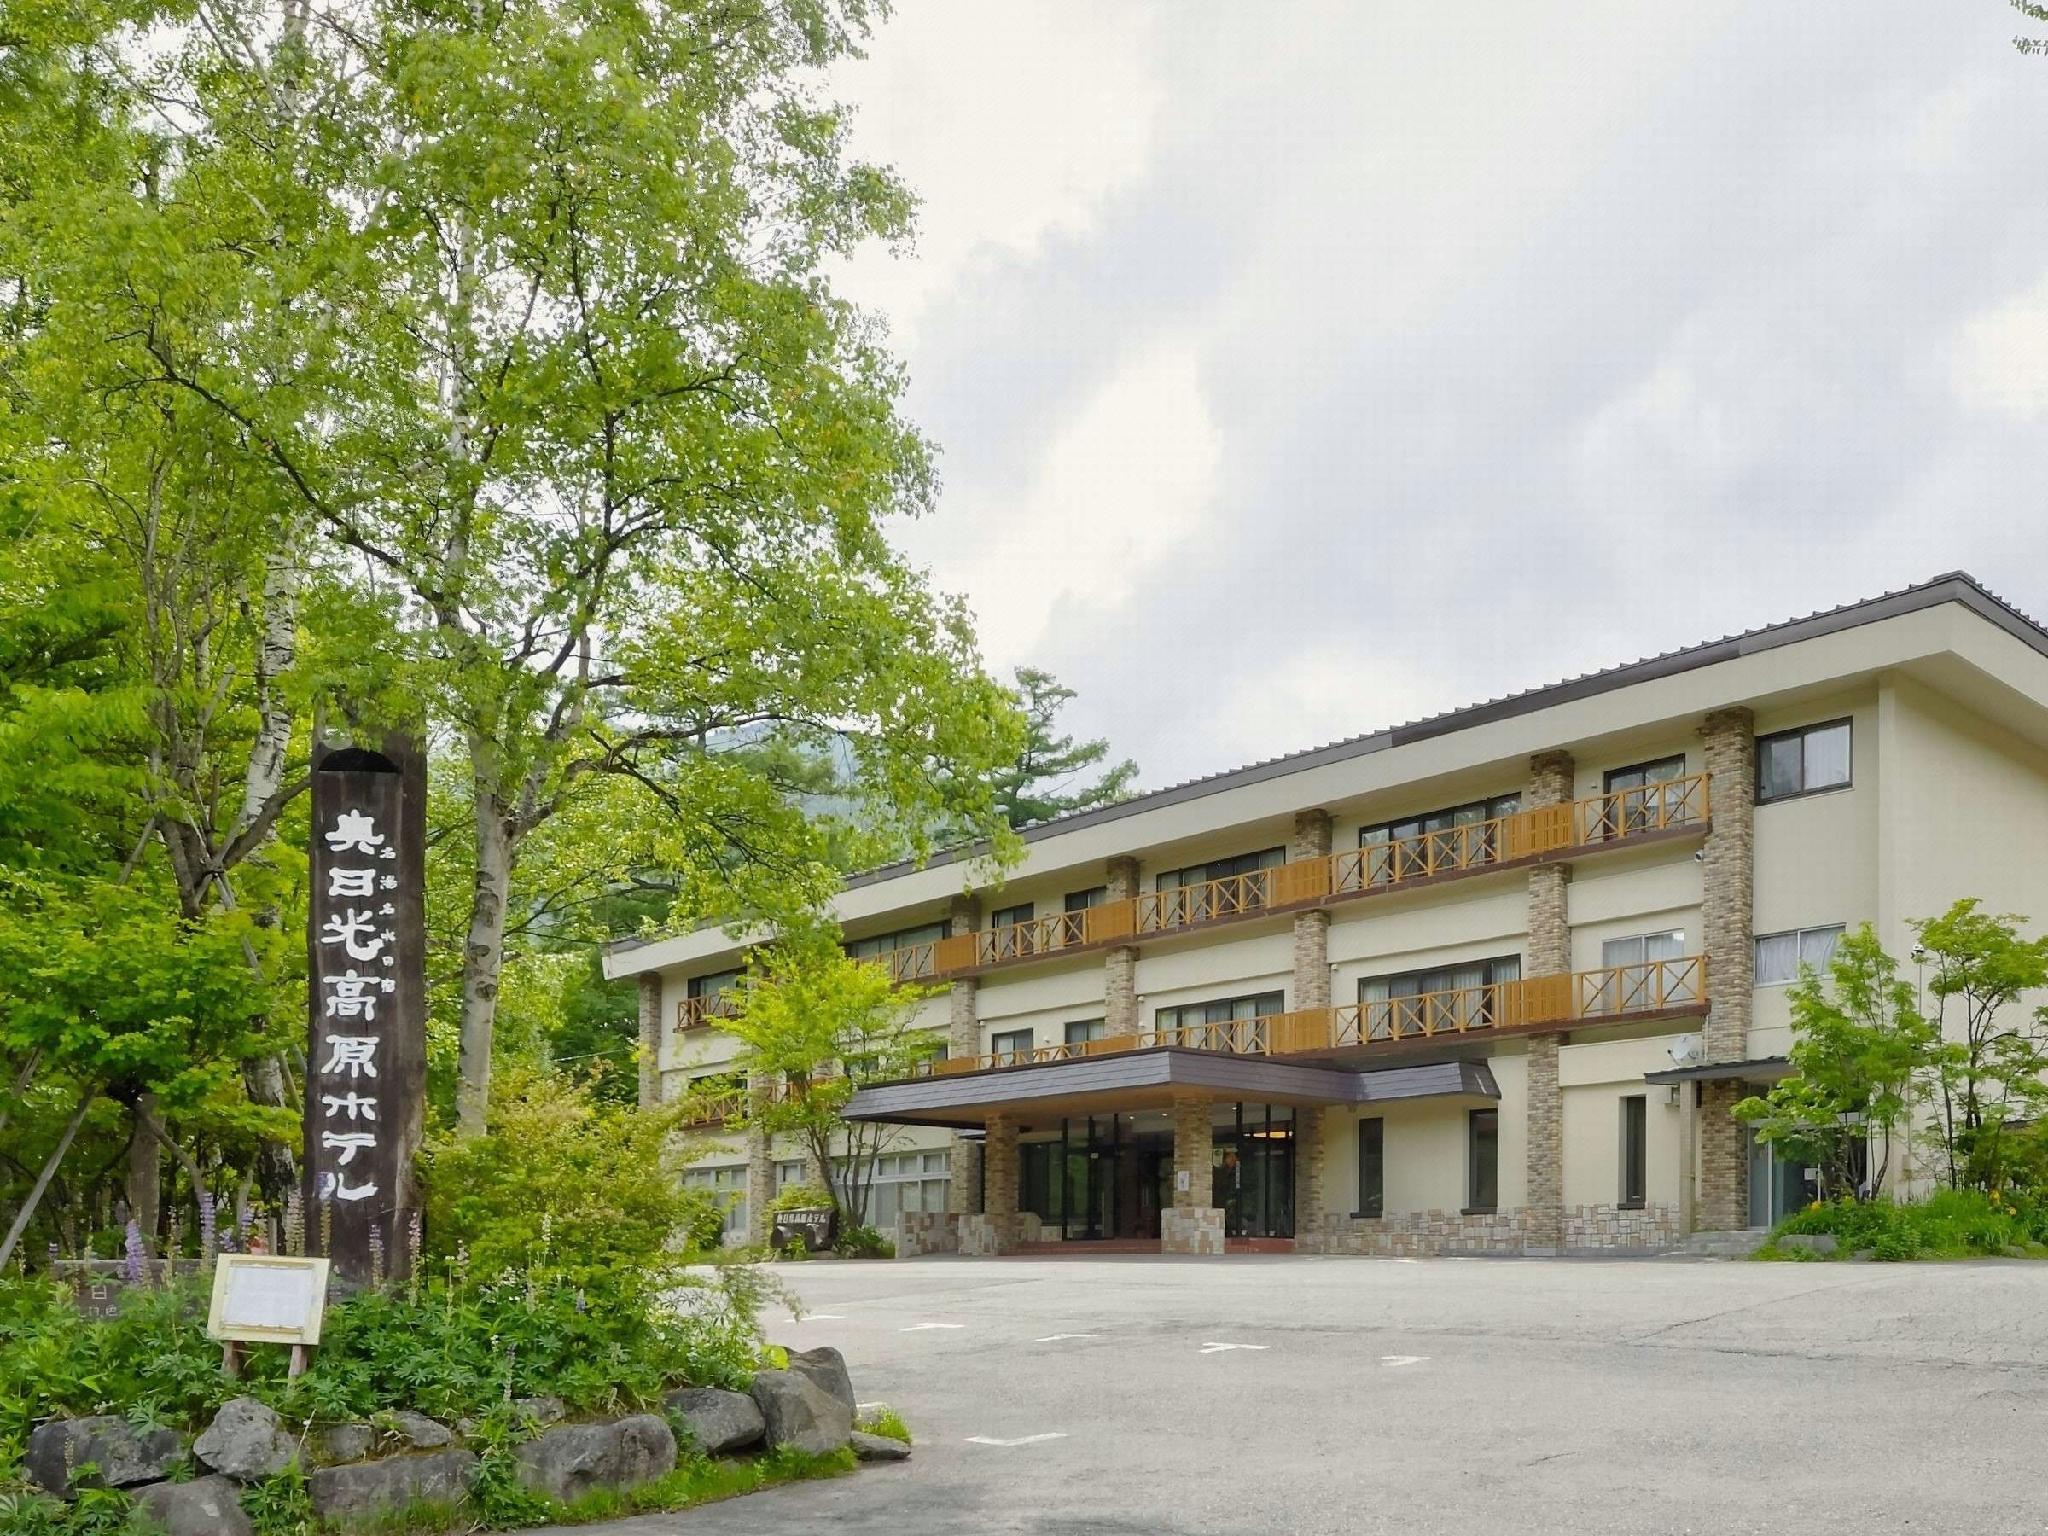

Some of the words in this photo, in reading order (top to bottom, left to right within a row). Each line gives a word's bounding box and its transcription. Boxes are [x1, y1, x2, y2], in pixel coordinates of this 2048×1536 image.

[319, 809, 385, 1201] 奥日光高原ホテル
